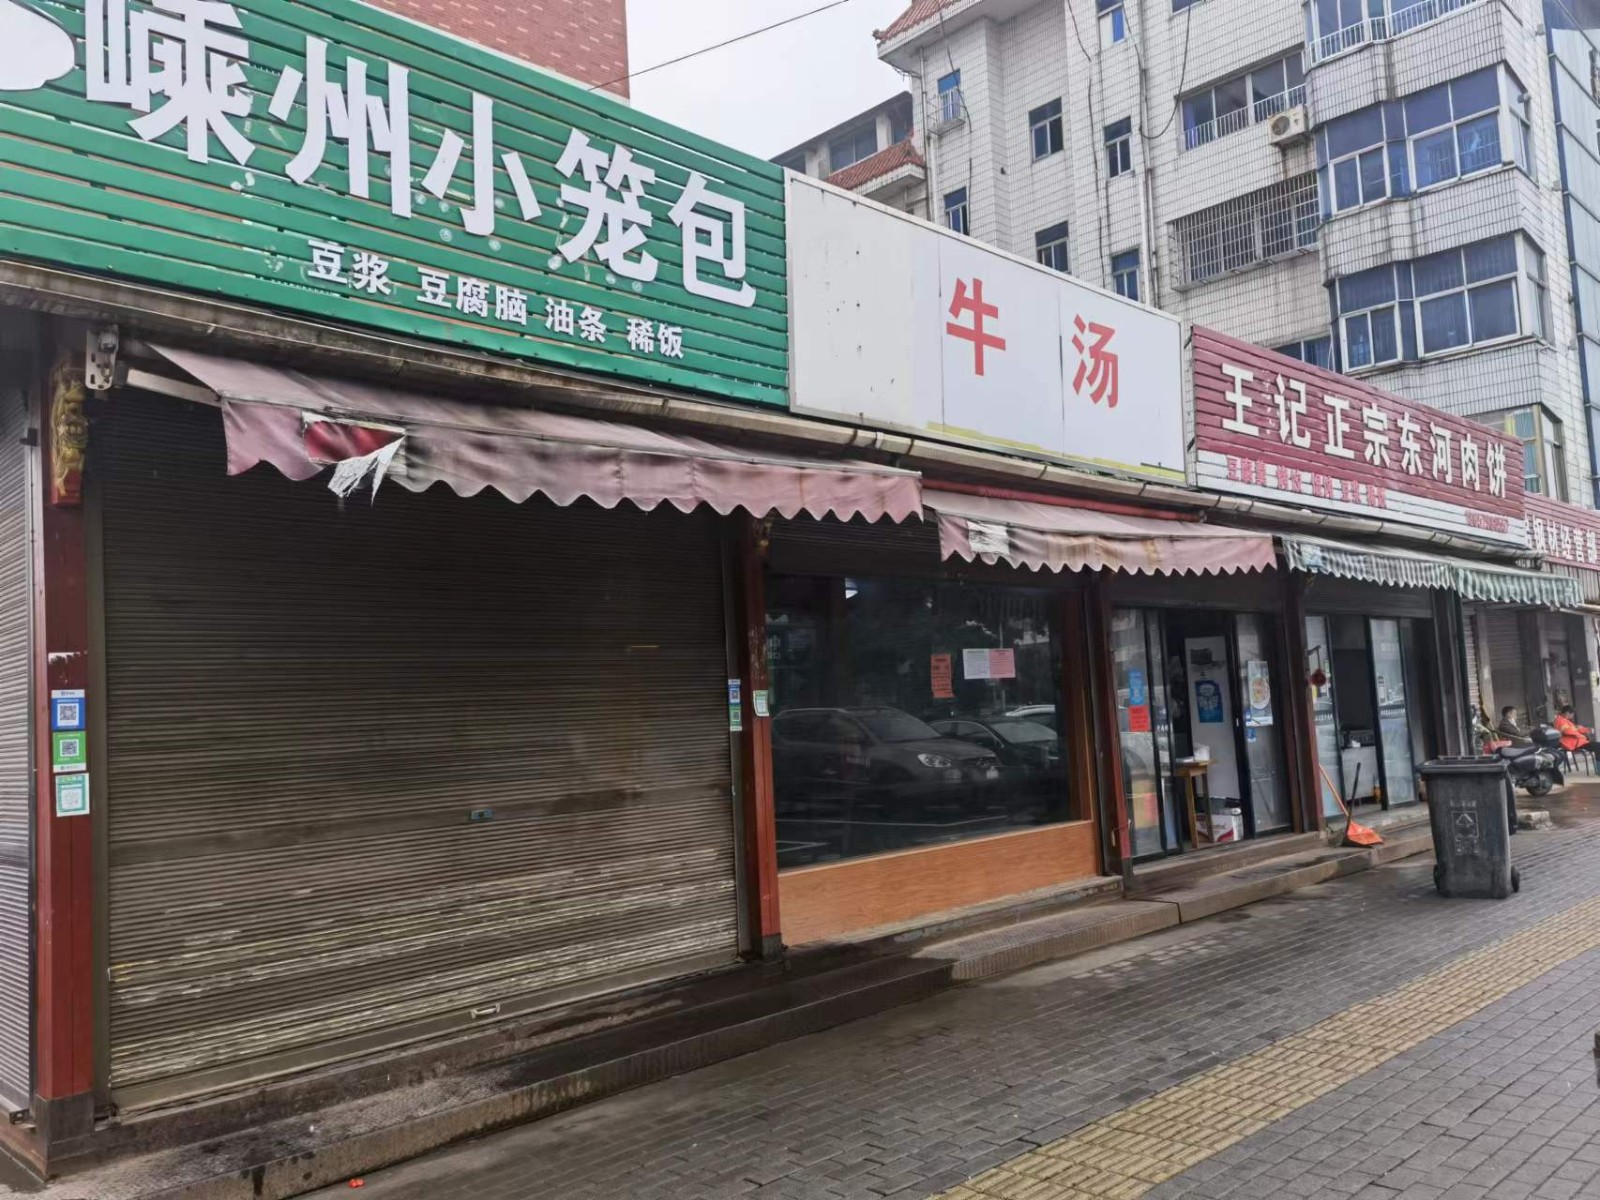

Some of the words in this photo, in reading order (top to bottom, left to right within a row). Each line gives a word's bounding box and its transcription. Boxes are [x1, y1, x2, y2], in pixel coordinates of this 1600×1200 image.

[86, 0, 756, 308] 嵊州小笼包
[307, 238, 392, 296] 豆浆
[416, 266, 528, 326] 豆腐脑
[545, 298, 607, 344] 油条
[626, 316, 684, 359] 稀饭
[1221, 362, 1507, 499] 王记正宗东河肉饼
